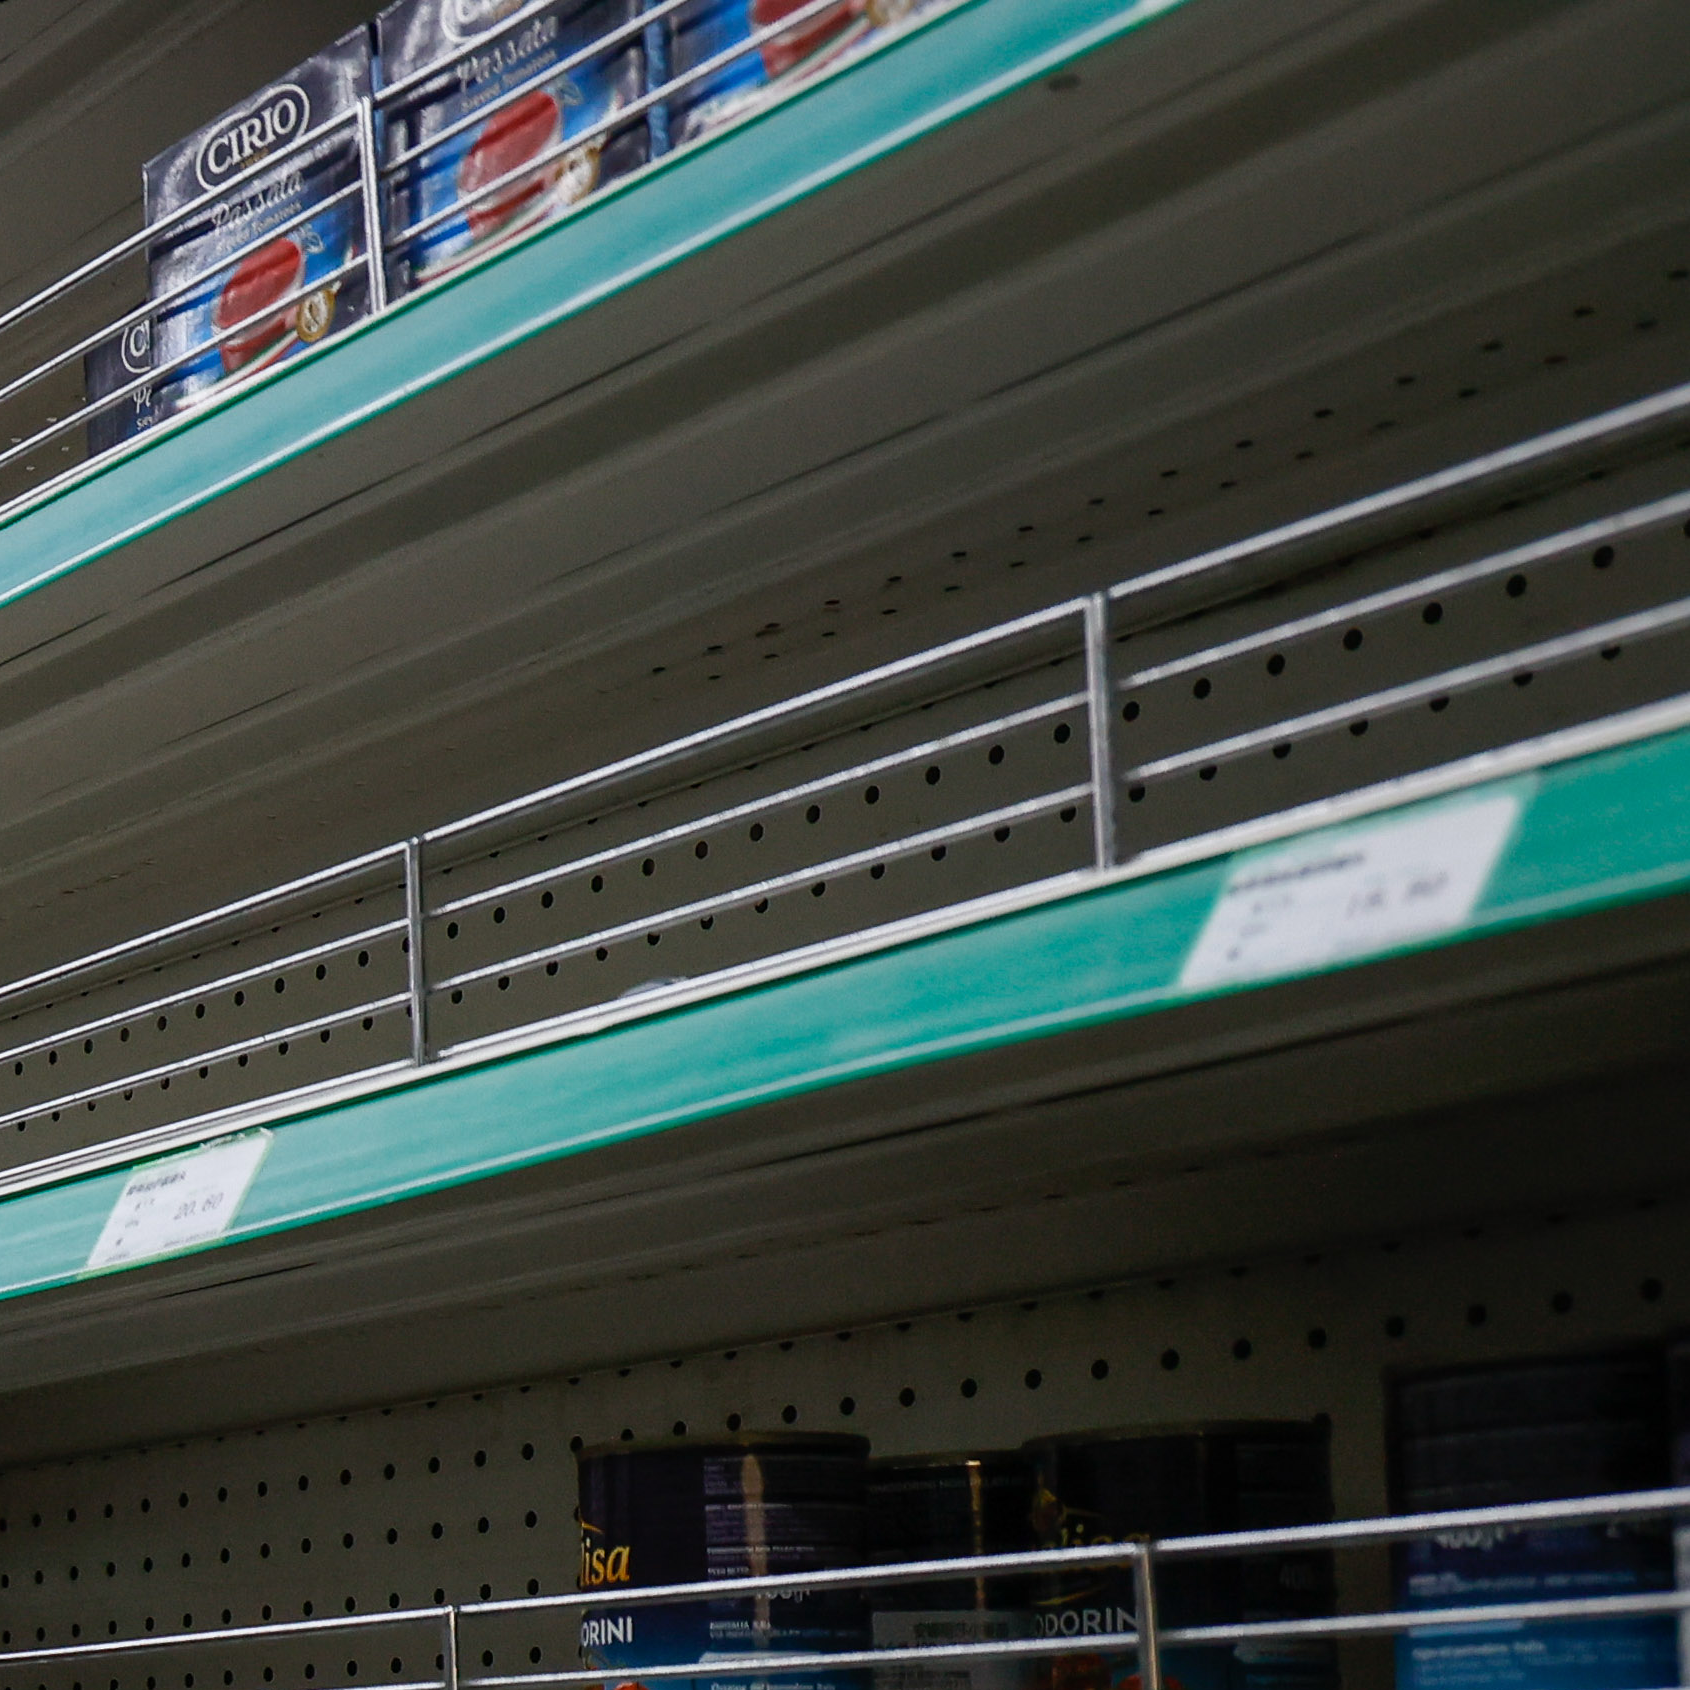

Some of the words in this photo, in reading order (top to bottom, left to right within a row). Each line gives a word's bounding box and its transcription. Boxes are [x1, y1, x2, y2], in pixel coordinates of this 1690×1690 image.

[207, 97, 298, 175] CIRIO
[580, 1536, 631, 1587] lisa
[1030, 1606, 1140, 1637] ODORIN
